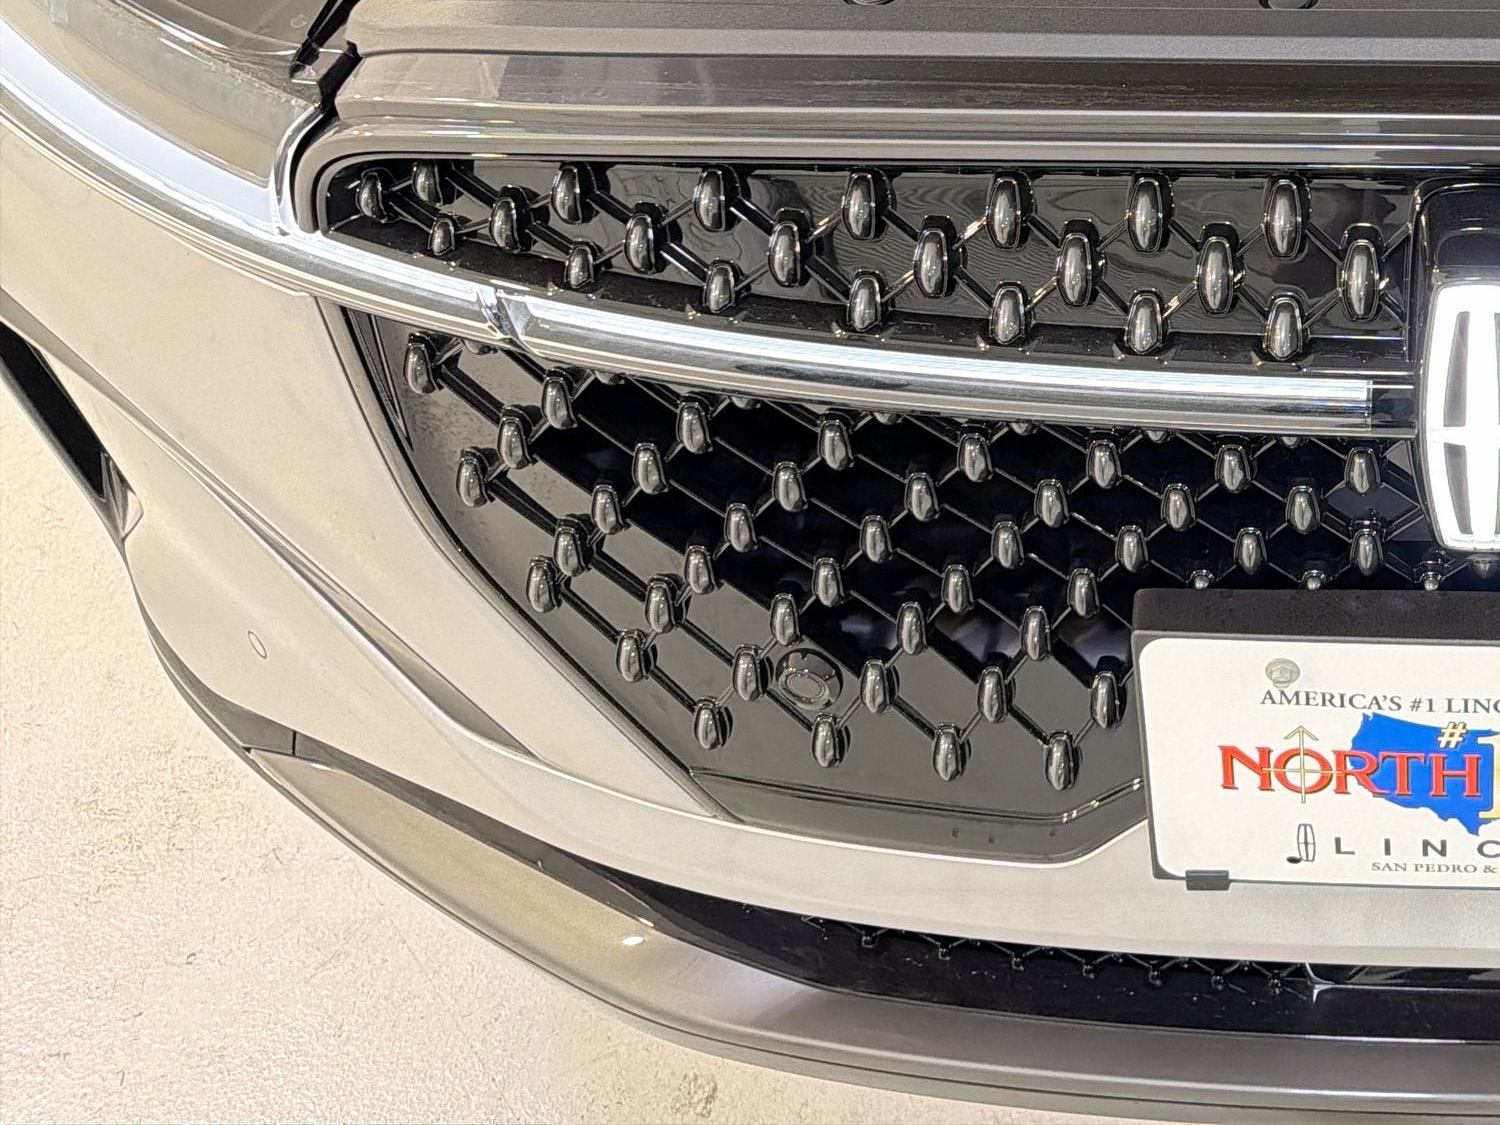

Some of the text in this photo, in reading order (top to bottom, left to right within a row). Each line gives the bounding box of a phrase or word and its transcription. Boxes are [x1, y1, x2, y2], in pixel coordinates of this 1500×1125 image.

[1259, 689, 1402, 712] AMERICA'S
[1409, 697, 1436, 713] #1
[1218, 745, 1482, 798] NORTH
[1371, 861, 1408, 872] SAN
[1413, 863, 1478, 873] PEDRO
[1483, 864, 1498, 874] &
